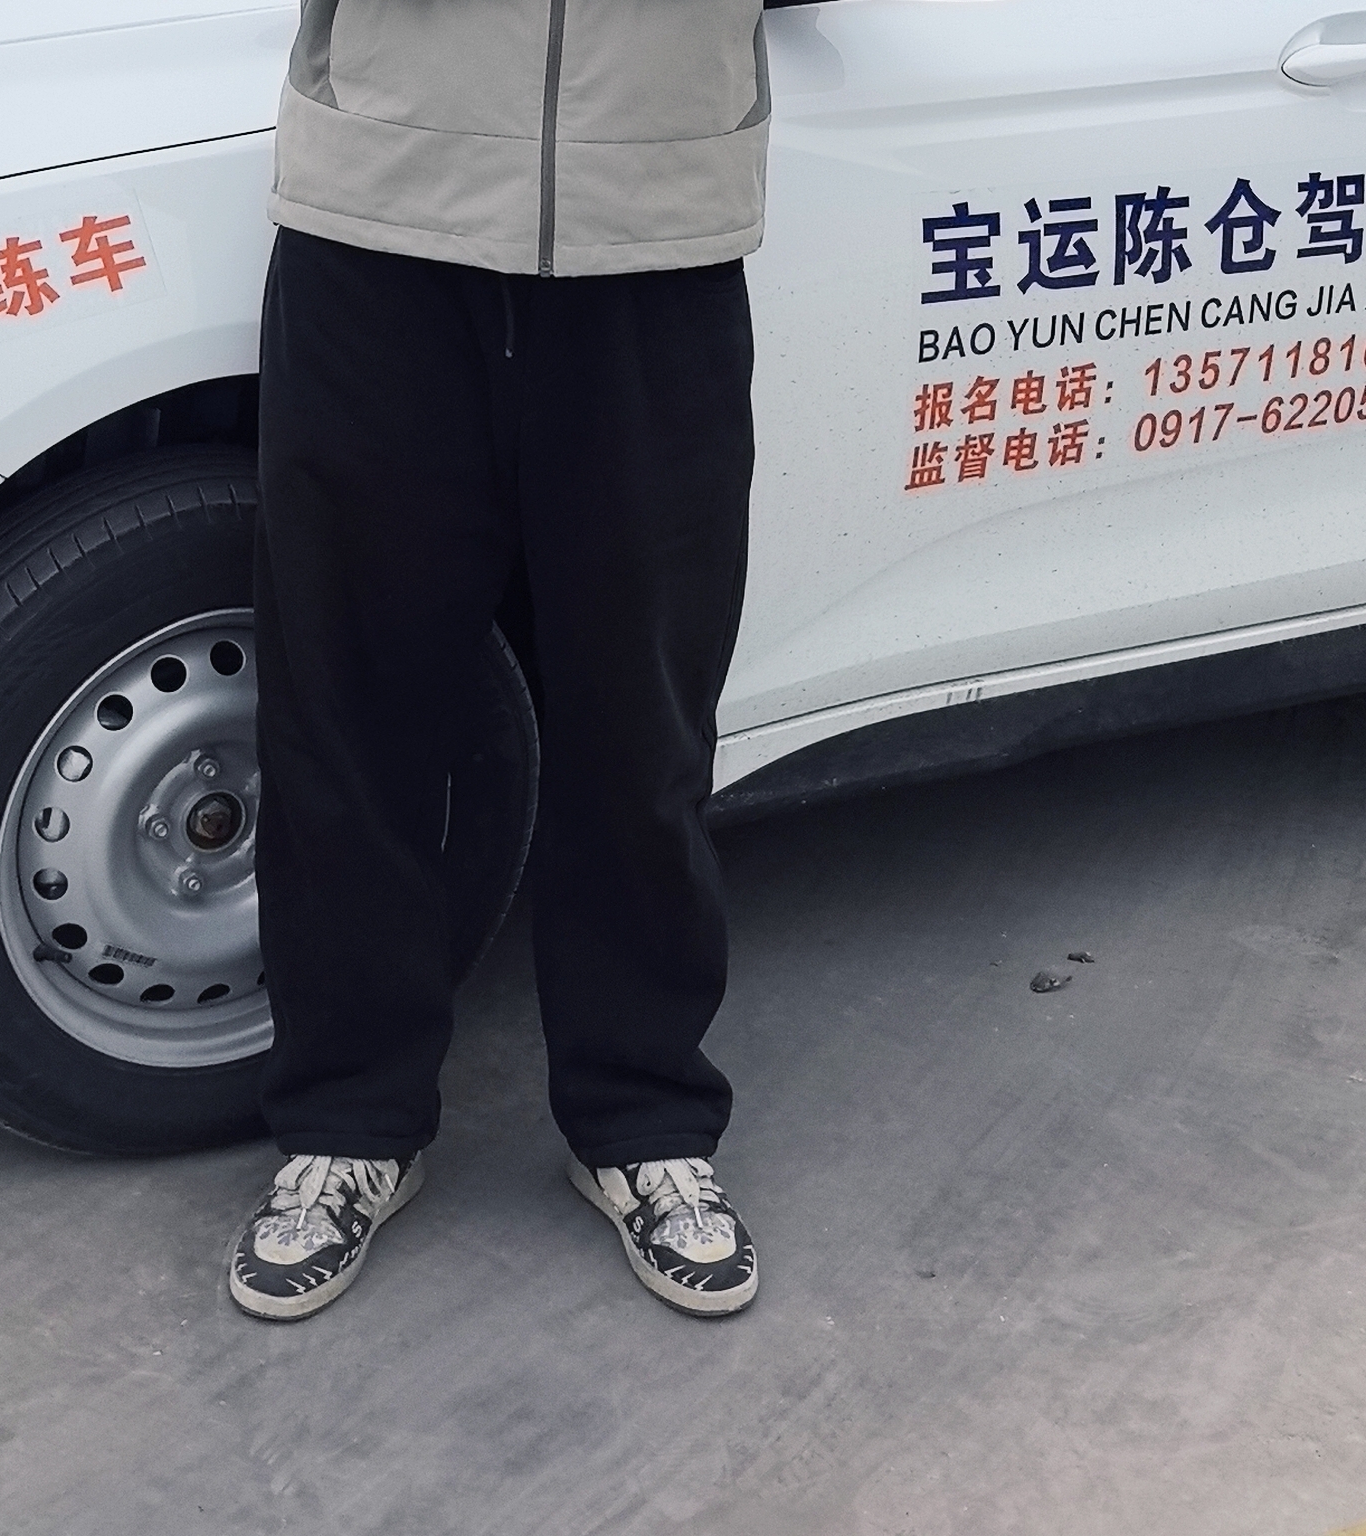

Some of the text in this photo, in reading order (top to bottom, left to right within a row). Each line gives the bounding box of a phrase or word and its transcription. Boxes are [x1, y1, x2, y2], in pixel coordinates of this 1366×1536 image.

[918, 322, 996, 364] BAO
[1006, 311, 1085, 352] YUN
[1095, 300, 1192, 341] CHEN
[1201, 289, 1298, 329] CANG
[1306, 282, 1356, 317] JIA
[913, 362, 1113, 432] 报名电话：
[904, 419, 1106, 491] 监督电话：
